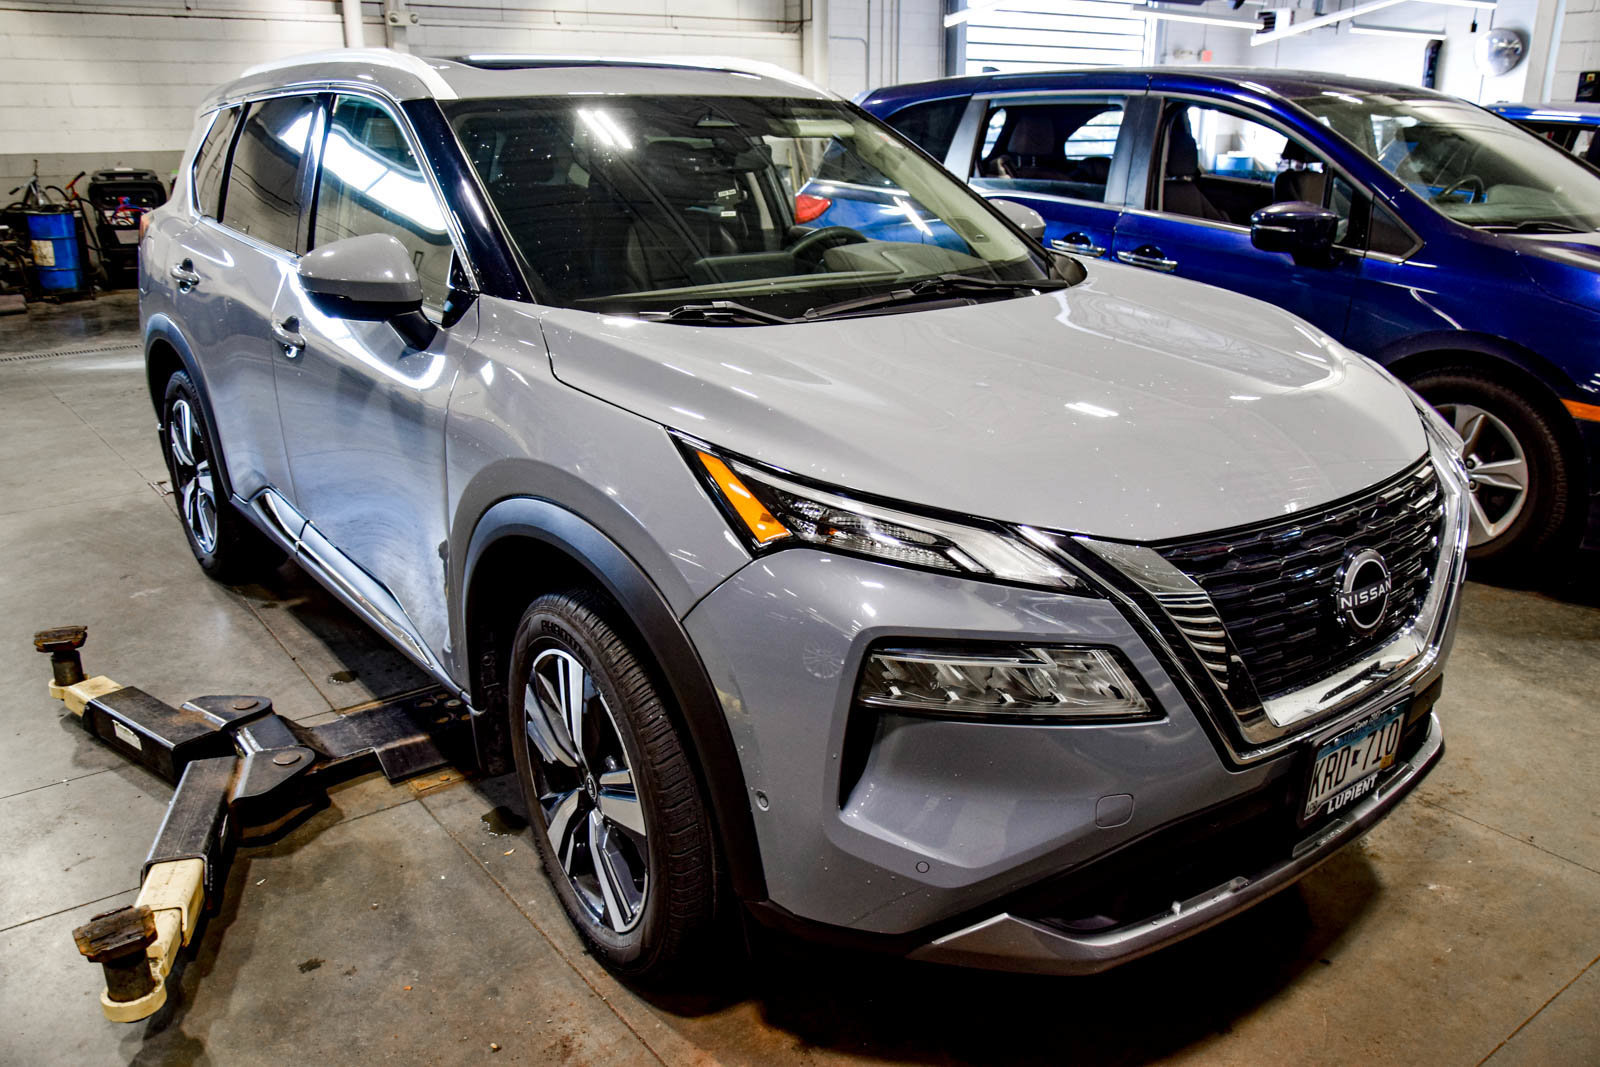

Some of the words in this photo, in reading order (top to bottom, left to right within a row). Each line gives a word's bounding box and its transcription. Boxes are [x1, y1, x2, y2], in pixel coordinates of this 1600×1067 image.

[1341, 576, 1391, 609] NISSAN
[1309, 745, 1351, 802] KRD
[1362, 718, 1400, 771] 710
[1327, 773, 1378, 815] LUPIENT
